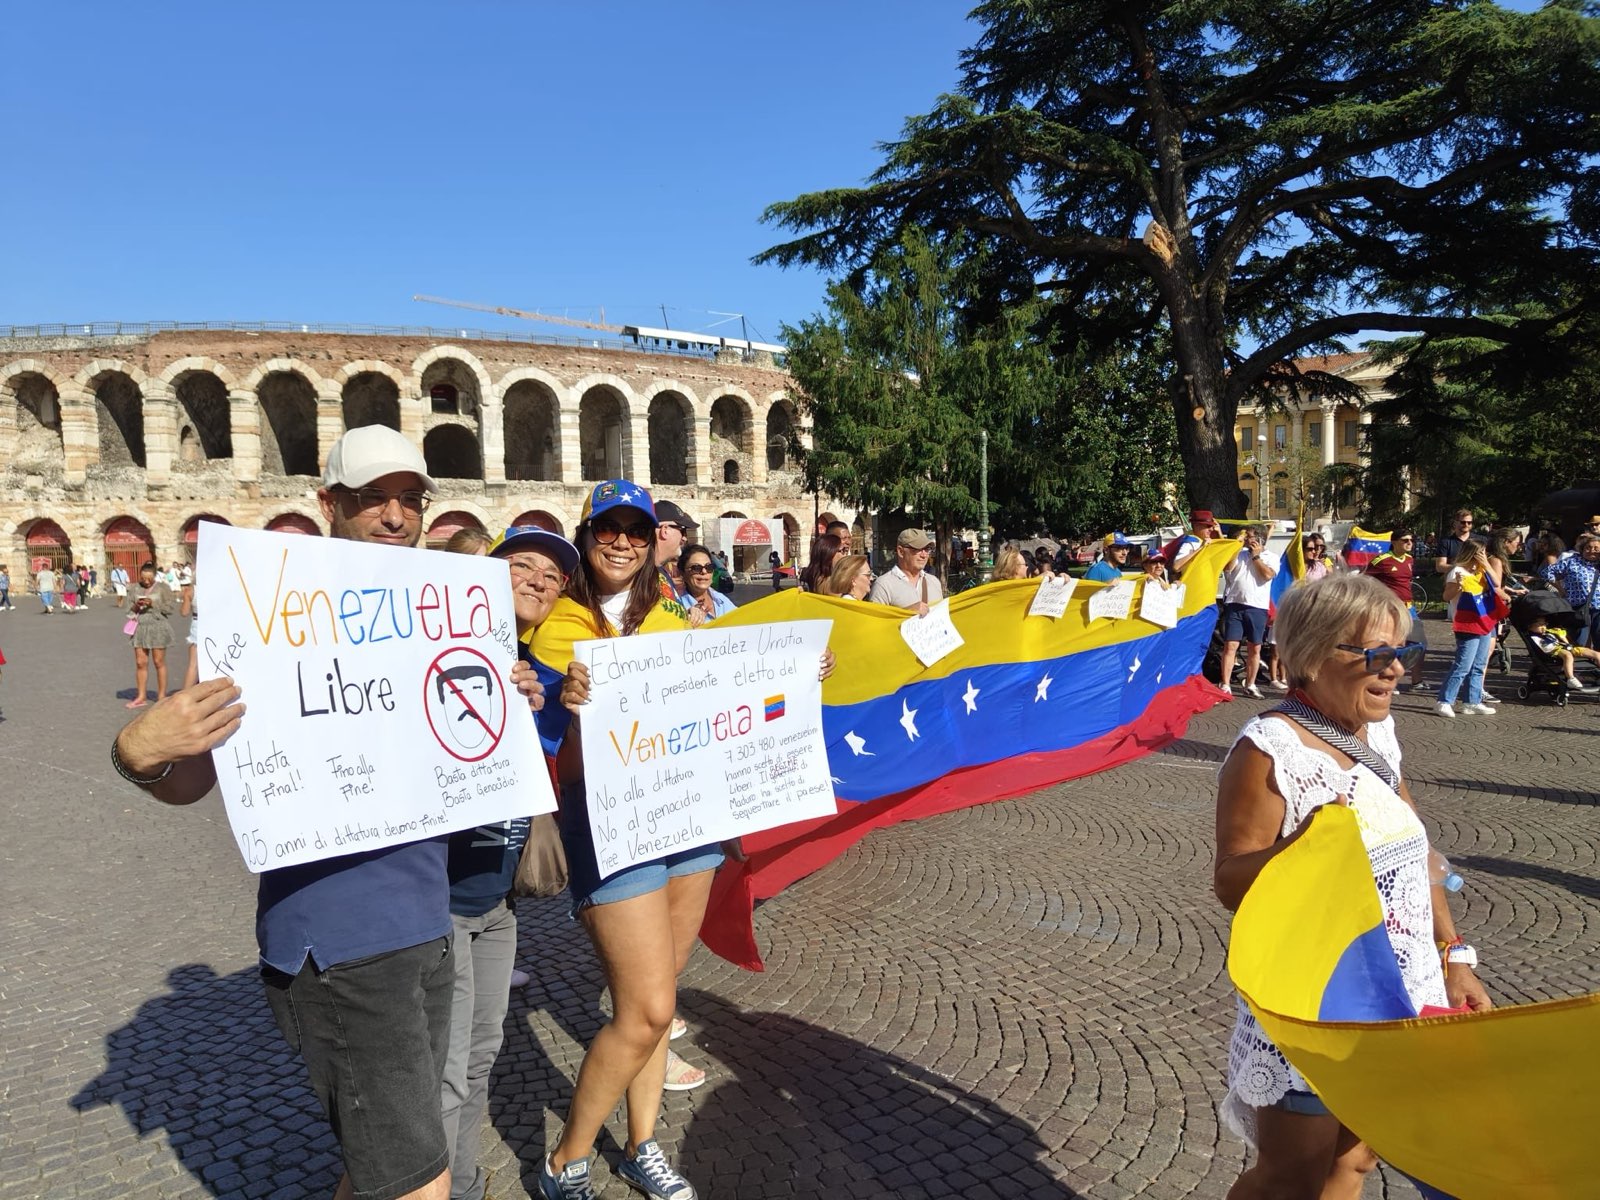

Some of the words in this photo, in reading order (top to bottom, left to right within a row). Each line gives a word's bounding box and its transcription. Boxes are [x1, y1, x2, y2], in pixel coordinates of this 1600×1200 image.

[591, 641, 672, 686] Edmundo
[683, 632, 747, 665] González
[757, 626, 803, 656] Urrutia
[298, 658, 395, 717] Libre
[618, 691, 629, 713] è
[642, 682, 652, 704] il
[661, 669, 718, 705] presidente
[733, 657, 775, 687] eletto
[779, 657, 797, 677] del
[234, 740, 290, 779] Hasta
[326, 754, 354, 779] Fino
[356, 753, 375, 776] alla
[724, 749, 733, 764] 7
[736, 741, 756, 761] 303
[758, 735, 775, 751] 480
[724, 766, 752, 782] hanno
[775, 752, 783, 762] di
[786, 743, 813, 759] essere
[241, 782, 254, 808] el
[434, 765, 466, 788] Basta
[441, 788, 472, 808] Basta
[476, 770, 519, 796] Genocidio!
[596, 783, 617, 814] No
[623, 774, 645, 803] alla
[652, 767, 695, 792] dittatura
[729, 793, 757, 810] Maduro
[760, 788, 771, 798] ha
[797, 775, 805, 785] di
[759, 770, 768, 785] Il
[796, 779, 830, 801] paese!
[597, 815, 618, 844] No
[627, 805, 640, 831] al
[646, 789, 701, 835] genocidio
[241, 828, 268, 866] 25
[275, 833, 306, 858] anni
[314, 830, 328, 850] di
[334, 822, 380, 846] dittatura
[384, 820, 418, 837] devono
[599, 847, 619, 873] Free
[627, 815, 704, 861] Venezuela
